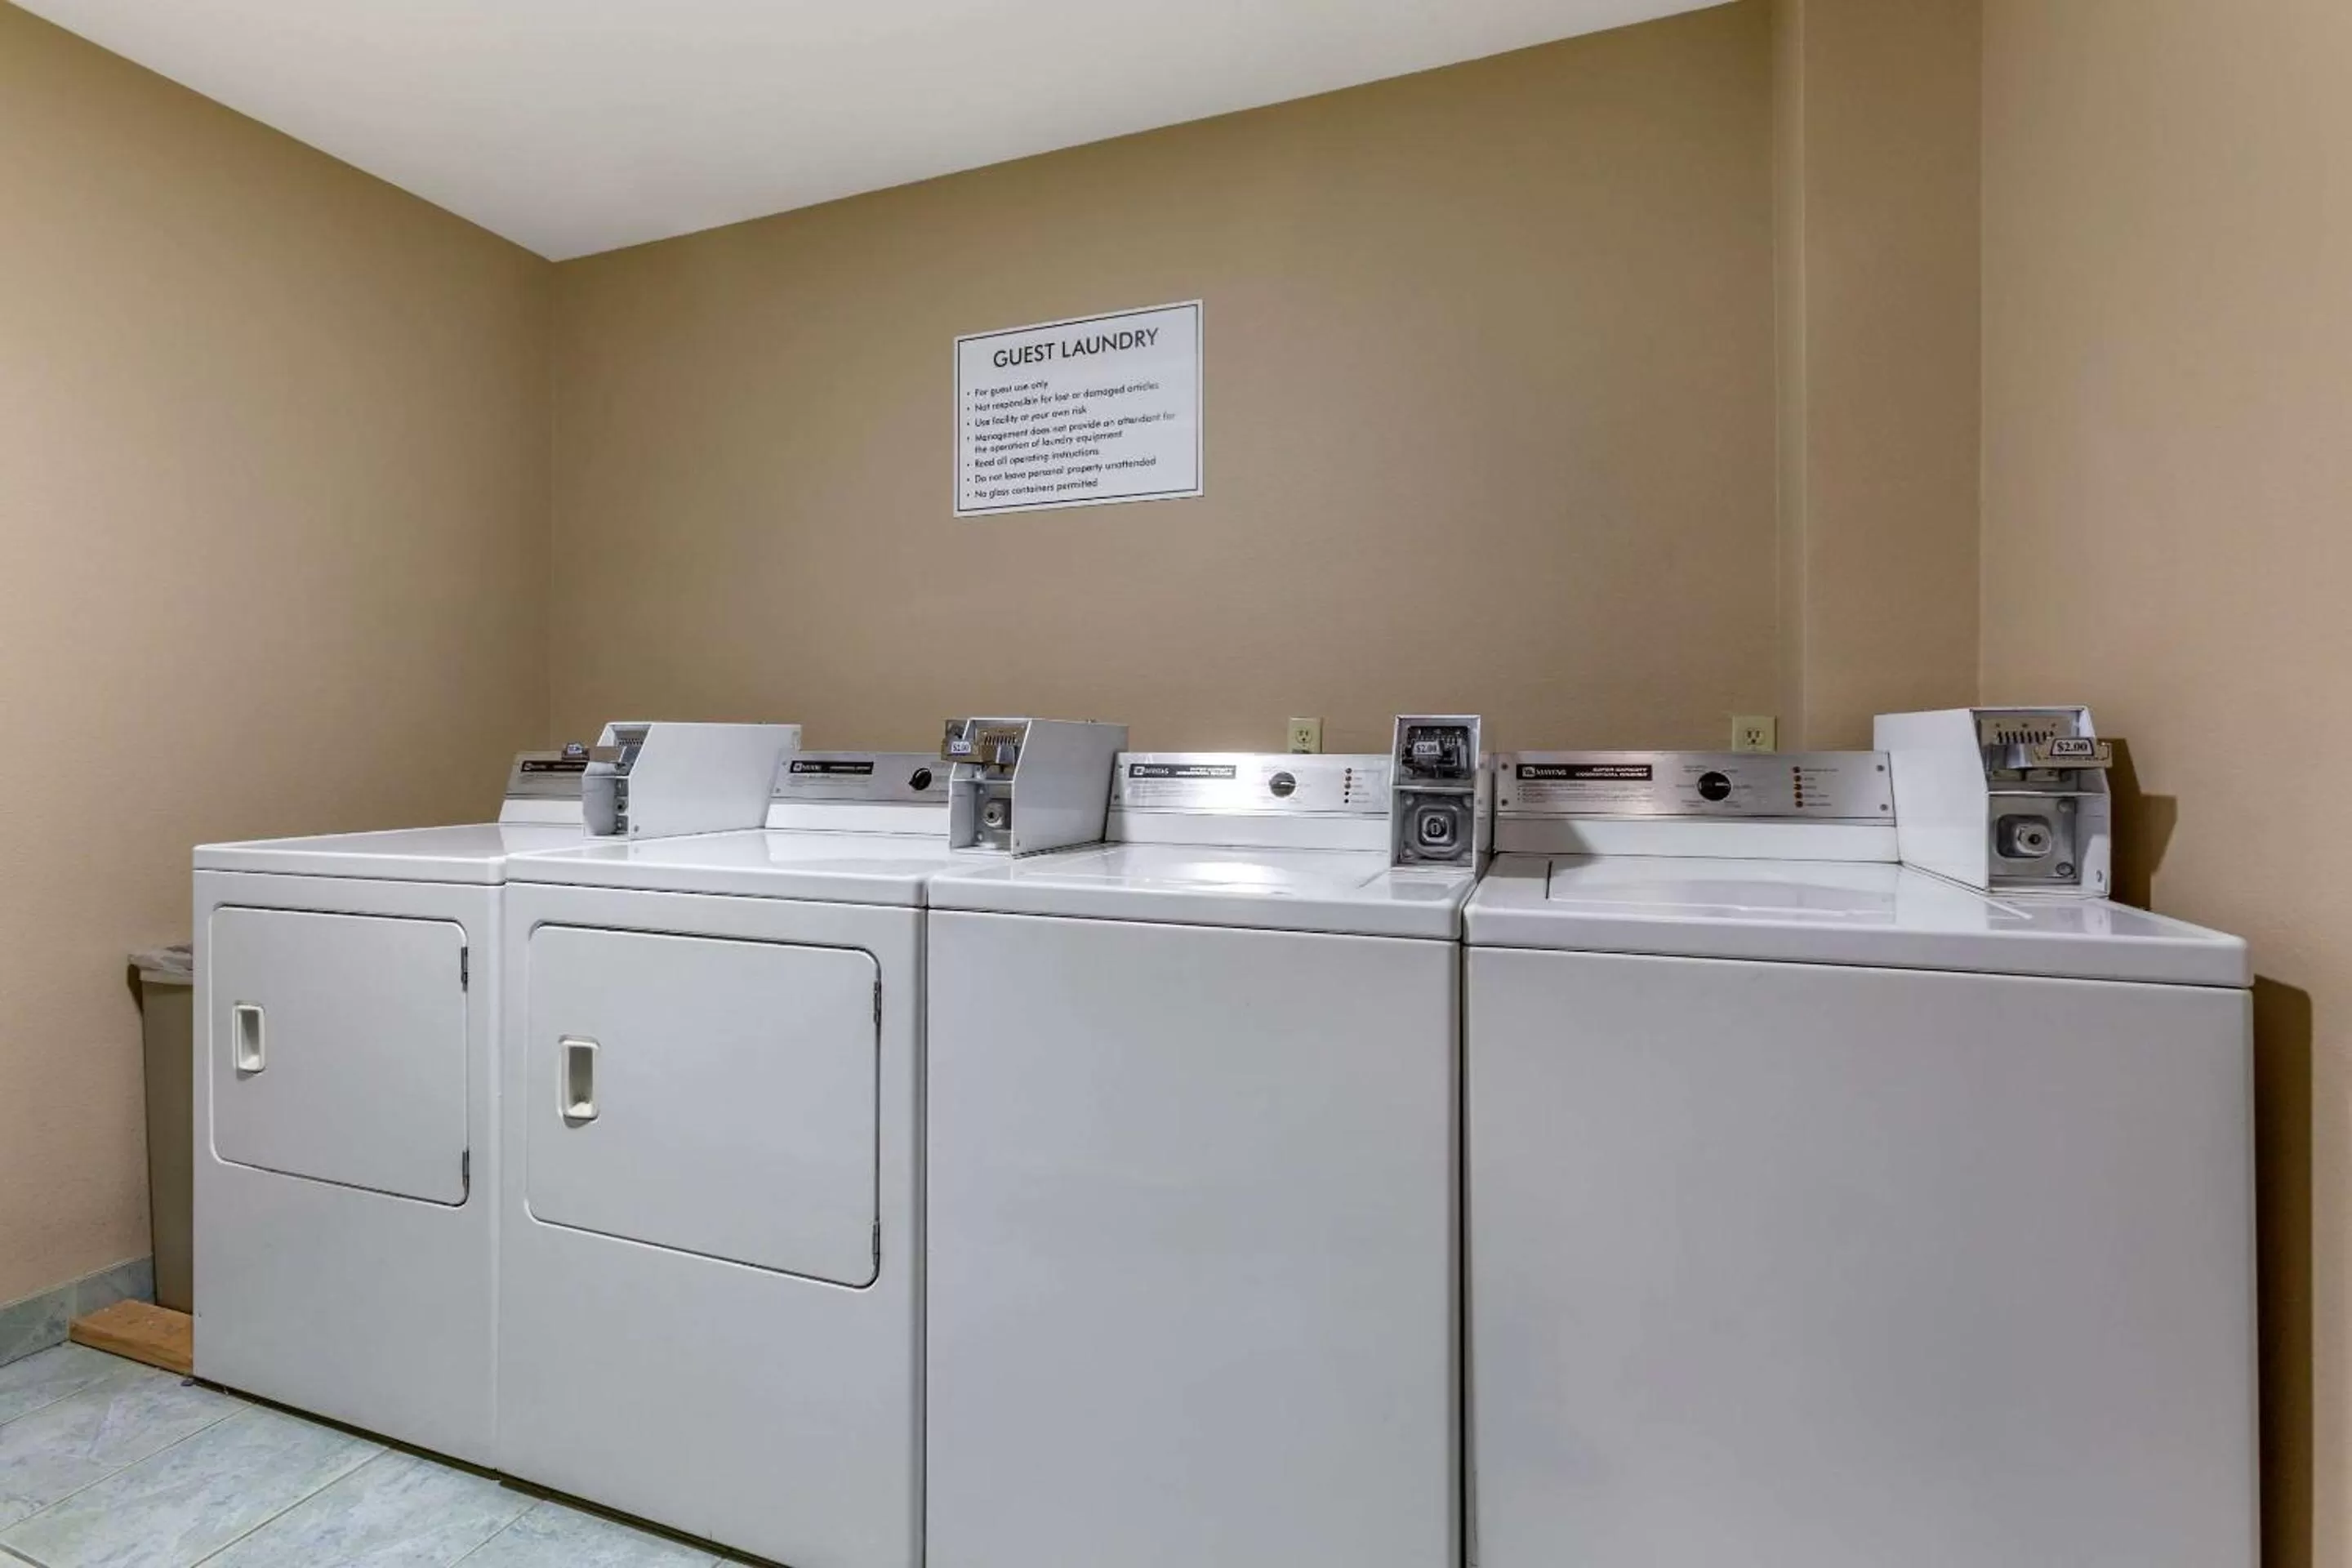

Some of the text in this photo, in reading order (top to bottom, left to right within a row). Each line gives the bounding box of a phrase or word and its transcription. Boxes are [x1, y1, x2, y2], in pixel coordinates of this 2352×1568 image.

[994, 327, 1159, 368] GUEST LAUNDRY
[974, 388, 987, 397] For
[991, 385, 1012, 397] guest
[974, 403, 990, 412] Not
[992, 397, 1038, 409] responsible
[1040, 394, 1052, 403] for
[1083, 385, 1125, 398] damaged
[1127, 381, 1159, 393] articles
[1031, 412, 1049, 422] your
[1051, 409, 1070, 417] own
[1071, 406, 1087, 415] risk
[974, 429, 1028, 442] Management
[1030, 426, 1050, 435] does
[1069, 420, 1101, 432] provide
[1117, 414, 1160, 425] attendant
[990, 441, 1029, 453] operation
[1031, 438, 1040, 448] of
[1042, 435, 1073, 446] laundry
[1076, 430, 1123, 444] equipment
[974, 457, 995, 468] Read
[1009, 453, 1049, 466] operating
[1052, 447, 1100, 459] instructions
[974, 474, 987, 483] Do
[1004, 471, 1027, 479] leave
[1028, 466, 1064, 480] personal
[1067, 463, 1103, 474] property
[1105, 457, 1156, 470] unattended
[974, 478, 1098, 499] No glass containers permitted
[2057, 741, 2088, 752] $2.00
